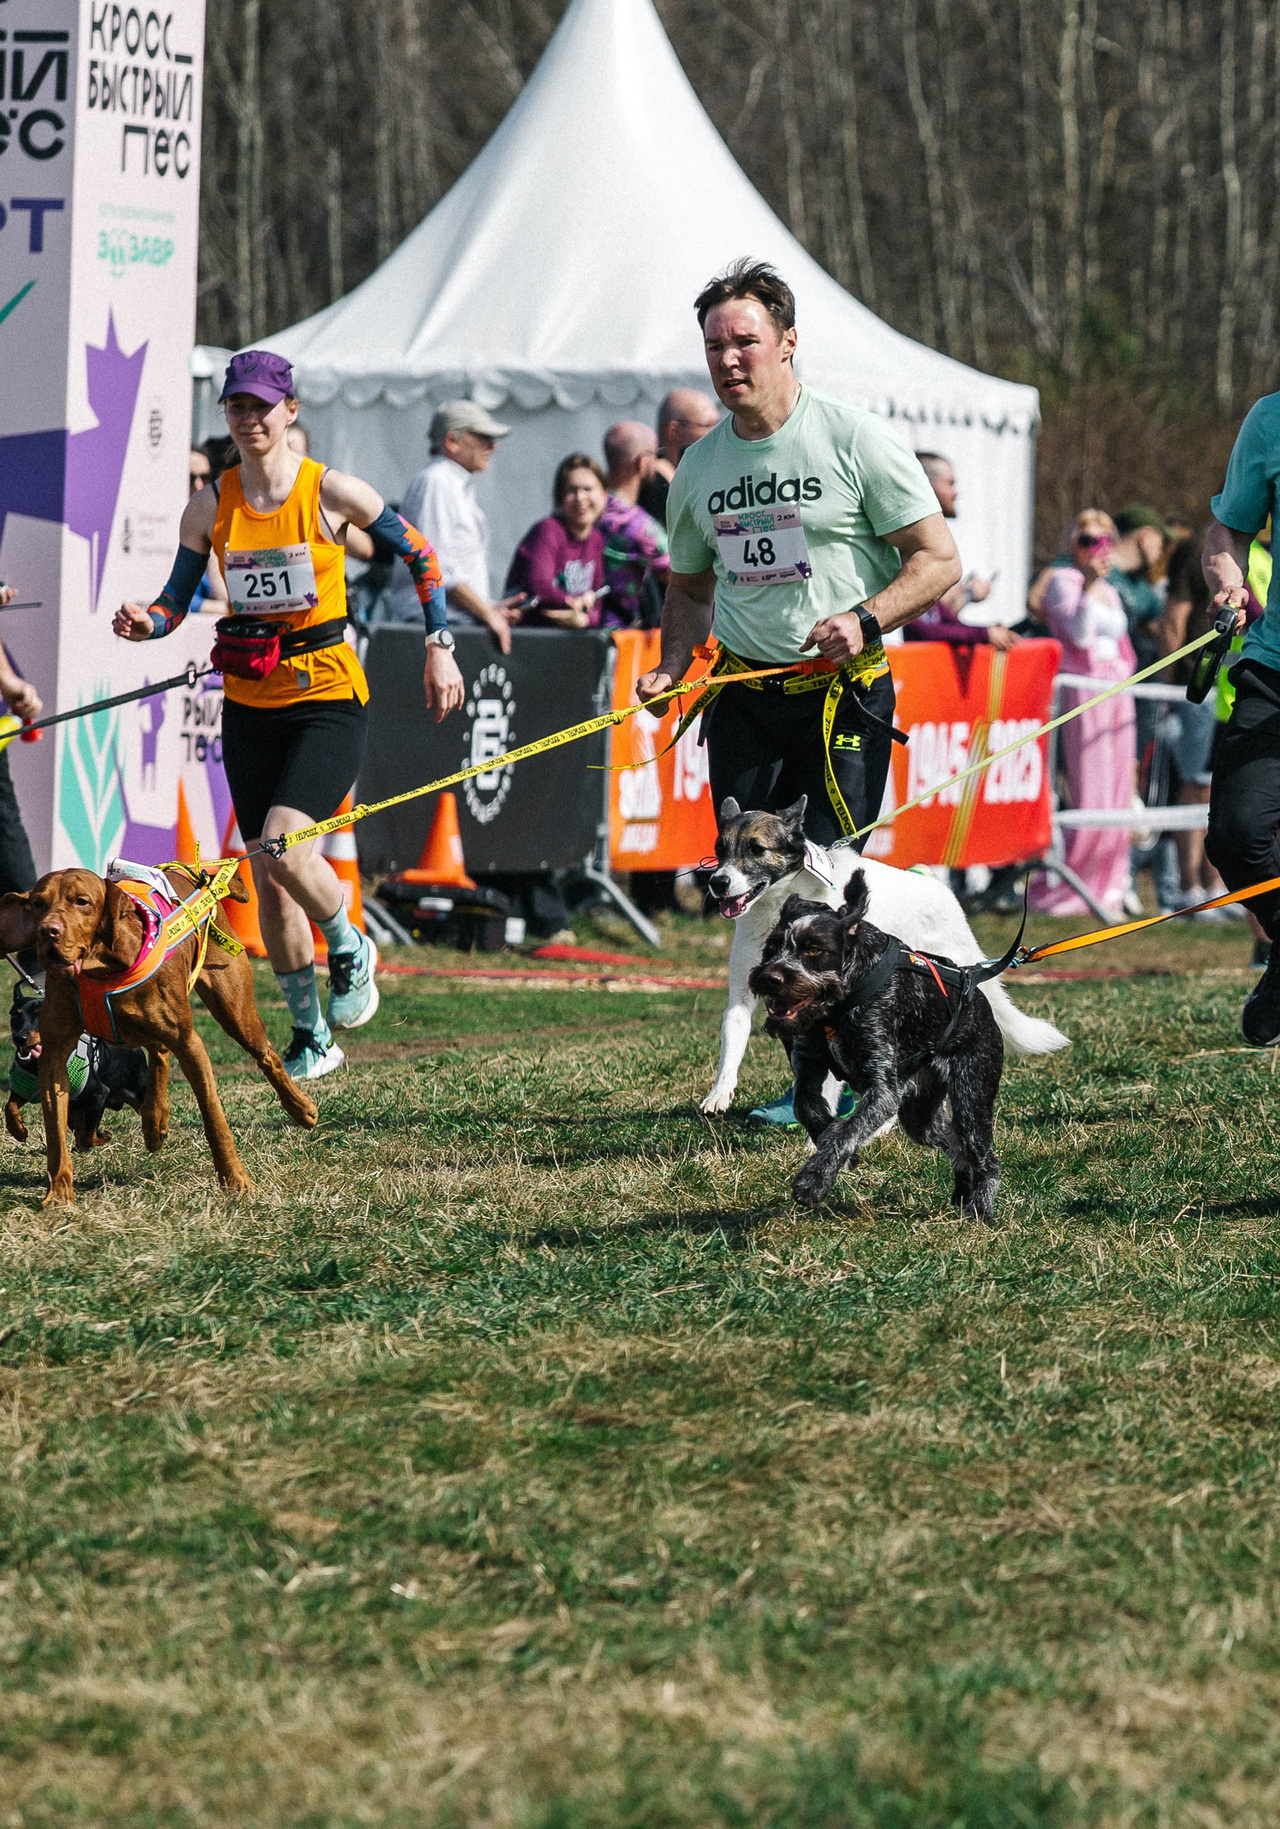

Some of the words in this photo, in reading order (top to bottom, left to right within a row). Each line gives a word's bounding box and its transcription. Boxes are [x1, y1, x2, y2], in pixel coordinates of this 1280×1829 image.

[708, 472, 823, 515] adidas
[743, 537, 776, 567] 48
[244, 570, 291, 598] 251
